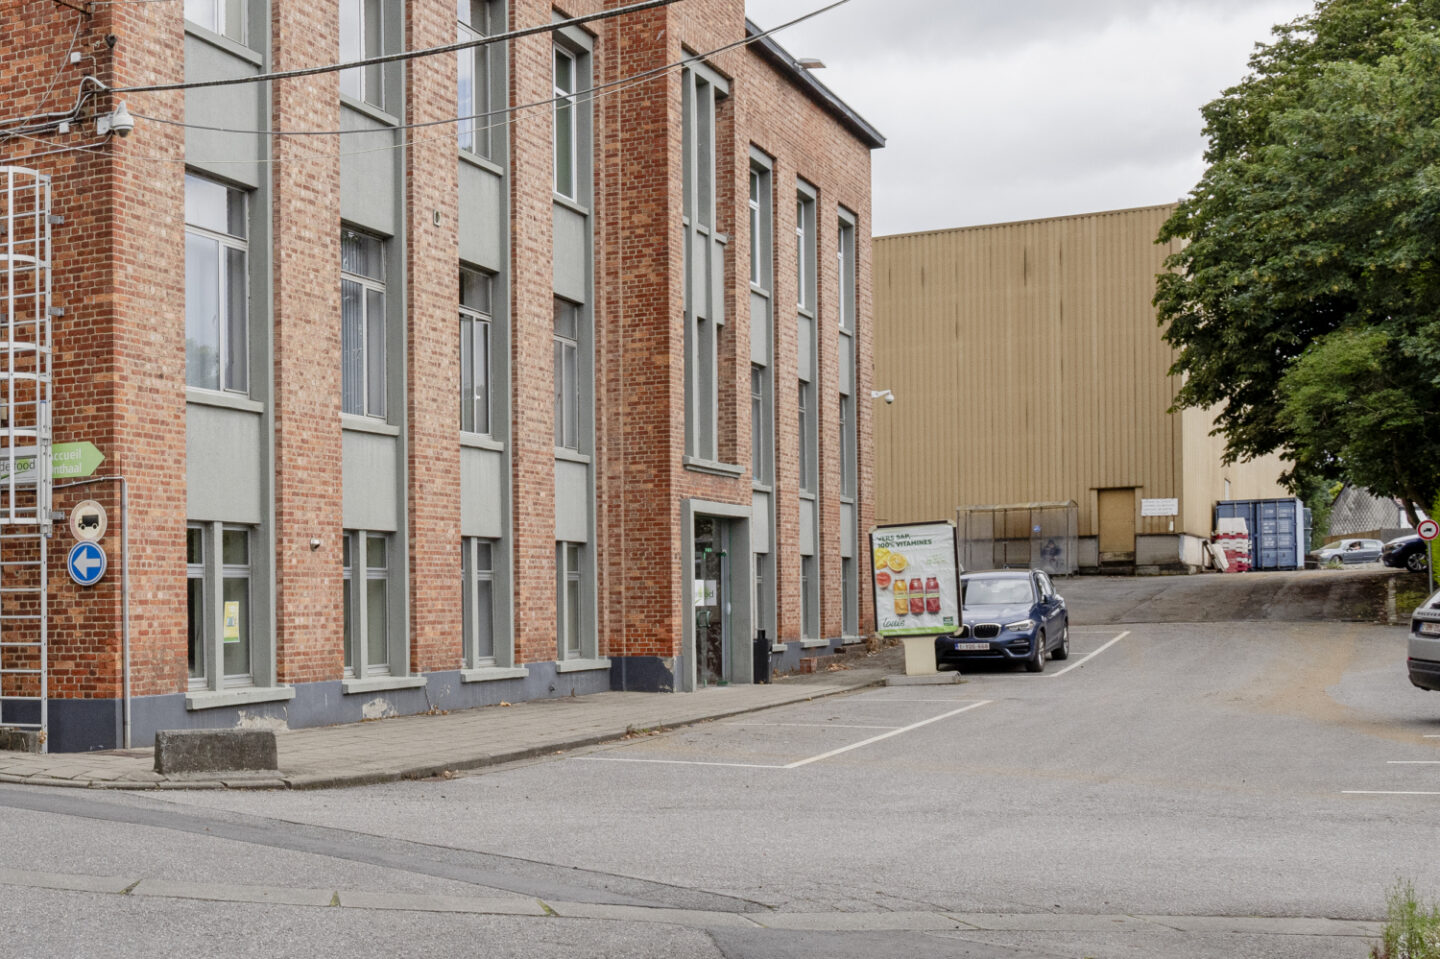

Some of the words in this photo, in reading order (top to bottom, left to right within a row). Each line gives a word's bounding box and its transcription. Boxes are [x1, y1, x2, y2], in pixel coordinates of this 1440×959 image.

[53, 447, 82, 461] ccueil
[53, 462, 82, 475] nthaal
[896, 539, 932, 547] VITAMINES
